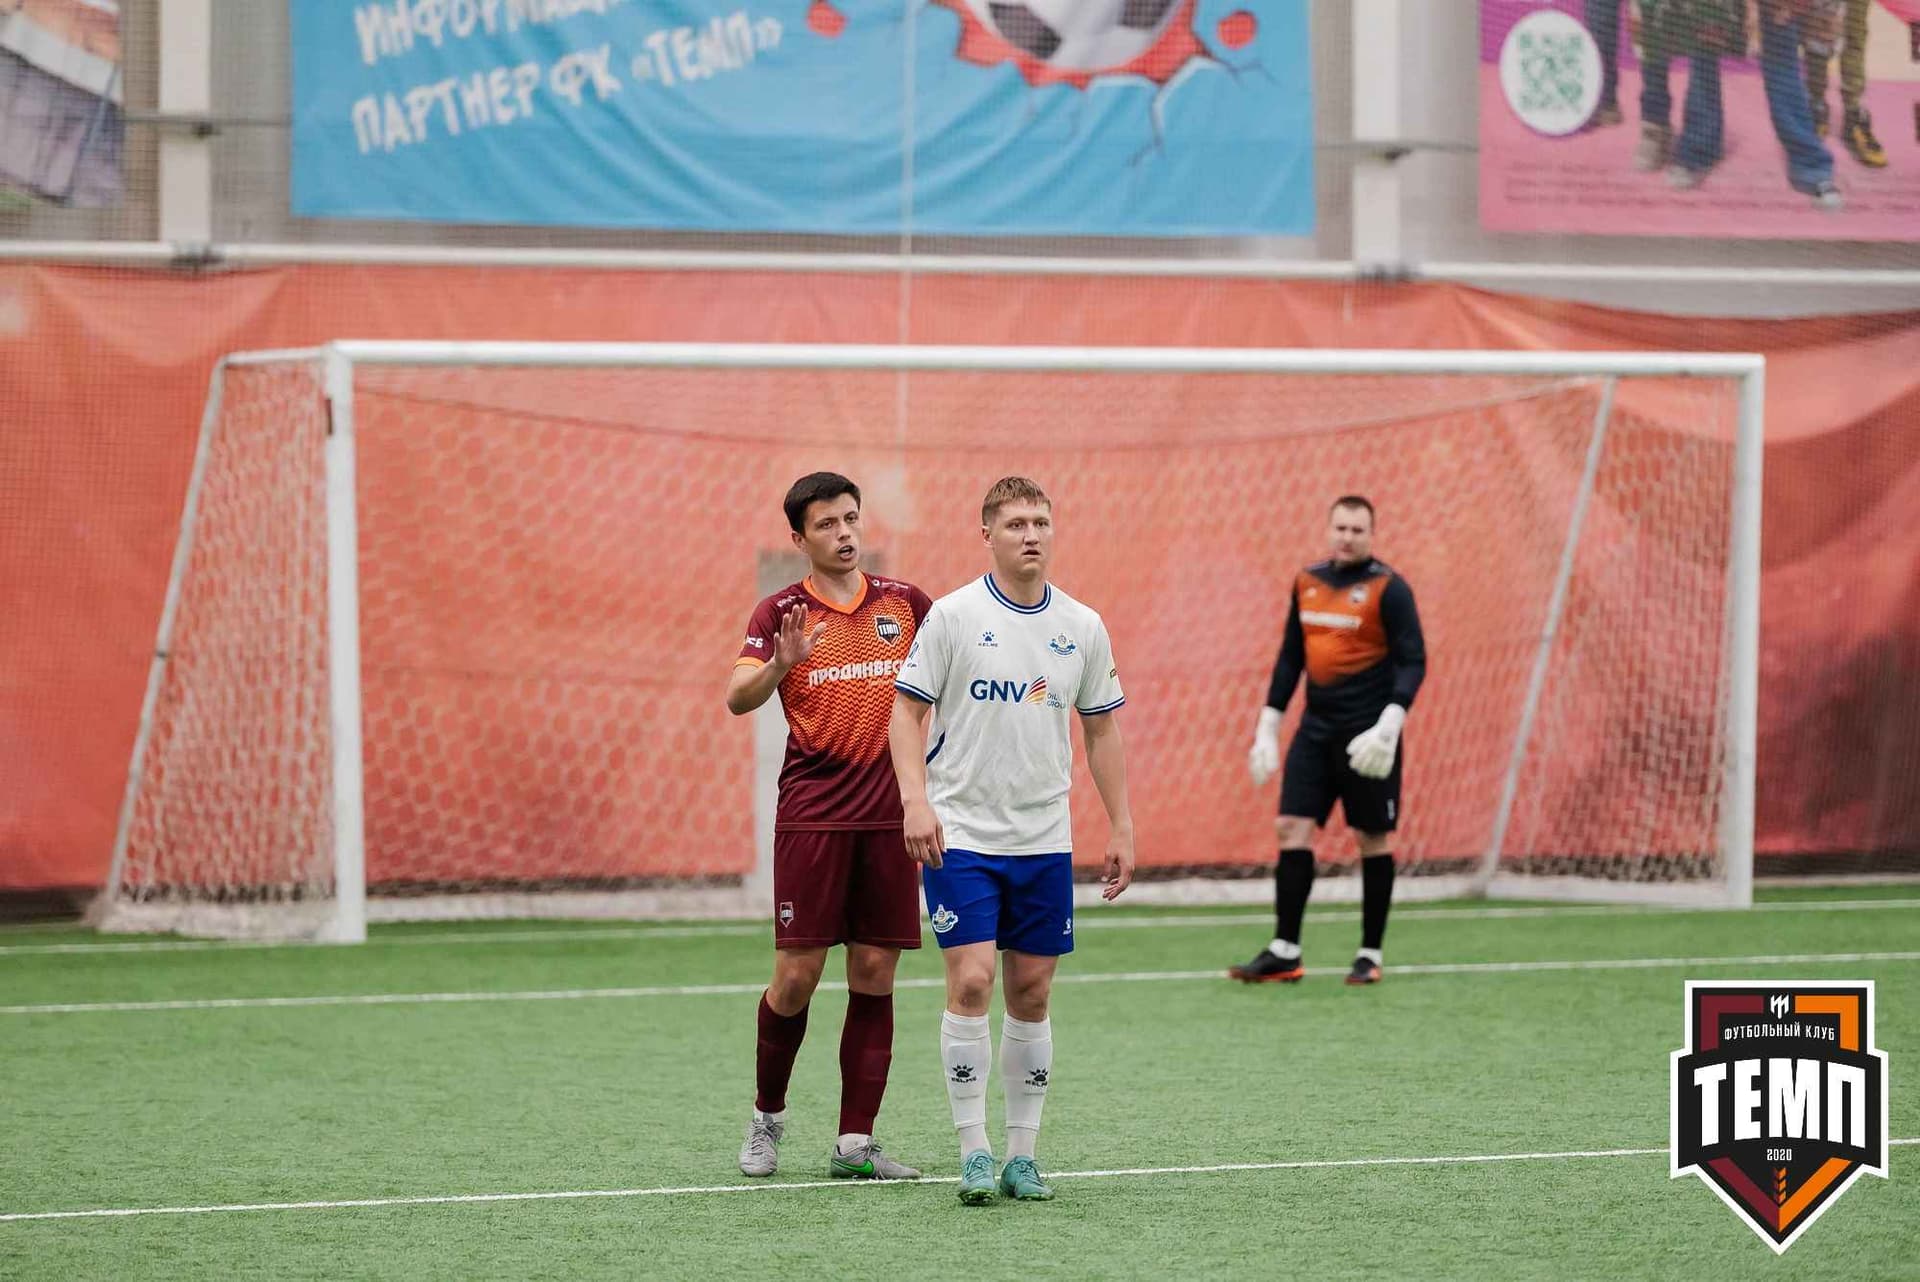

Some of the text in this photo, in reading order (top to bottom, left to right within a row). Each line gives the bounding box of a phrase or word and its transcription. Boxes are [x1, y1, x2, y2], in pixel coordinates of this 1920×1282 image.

[351, 63, 541, 154] ПАРТНЕР
[549, 43, 623, 106] ФК
[970, 679, 1027, 703] GNV
